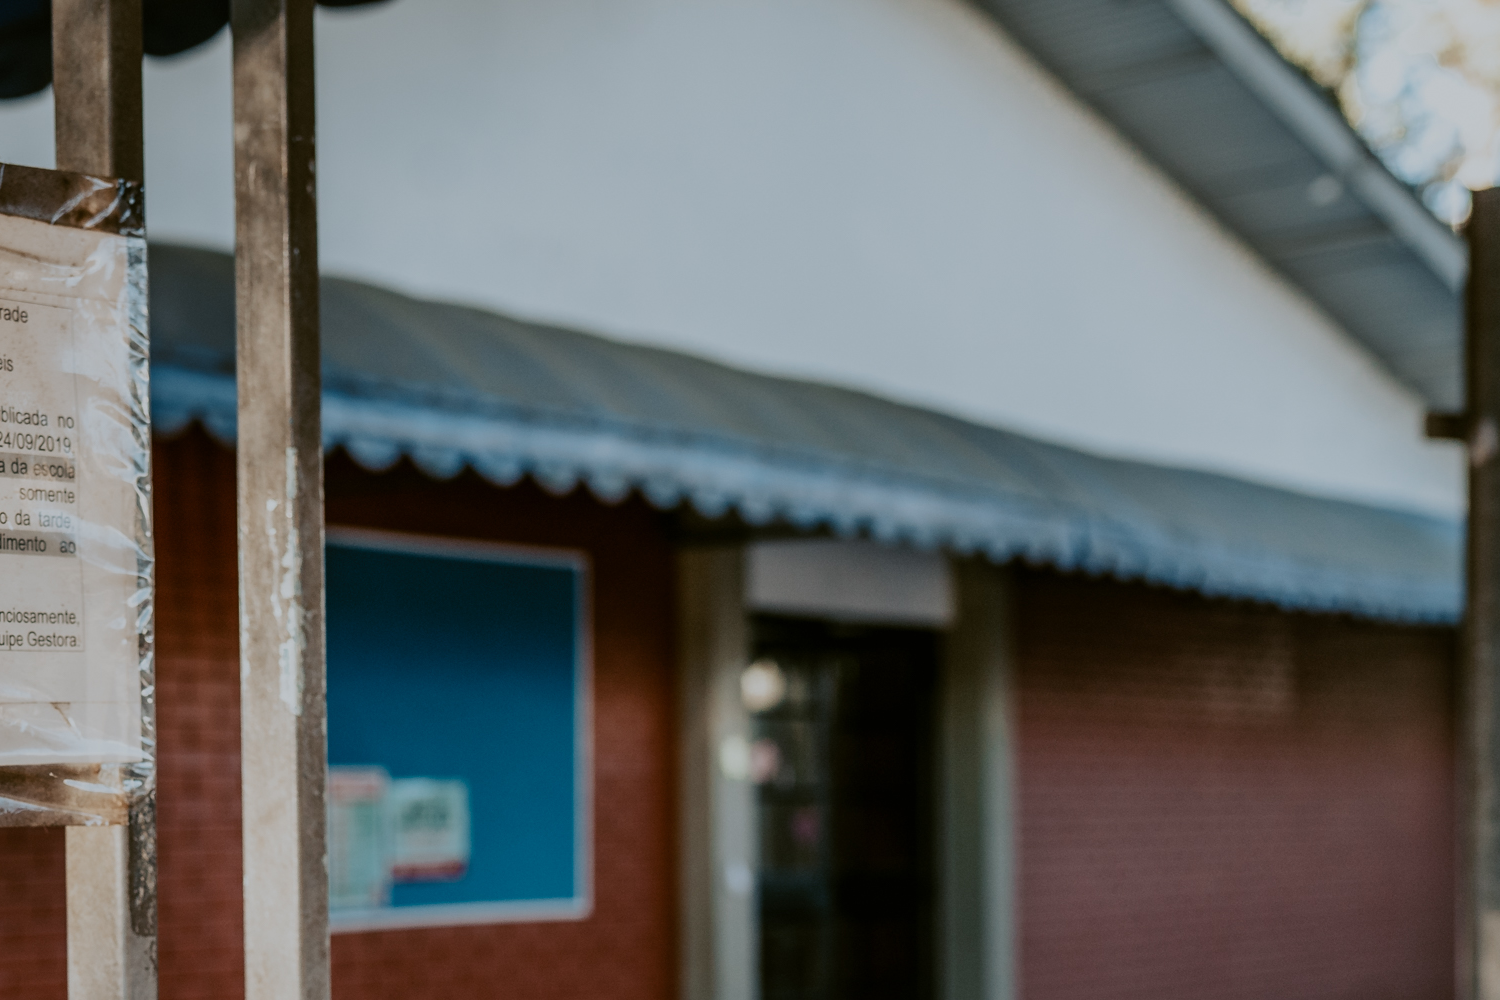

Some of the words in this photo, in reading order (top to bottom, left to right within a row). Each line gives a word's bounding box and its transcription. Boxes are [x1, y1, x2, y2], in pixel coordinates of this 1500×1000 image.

[57, 414, 75, 429] no
[10, 457, 28, 475] da
[33, 462, 75, 480] escola
[19, 487, 75, 504] somente
[14, 509, 31, 526] da
[38, 511, 75, 531] tarde,
[59, 540, 77, 555] ao
